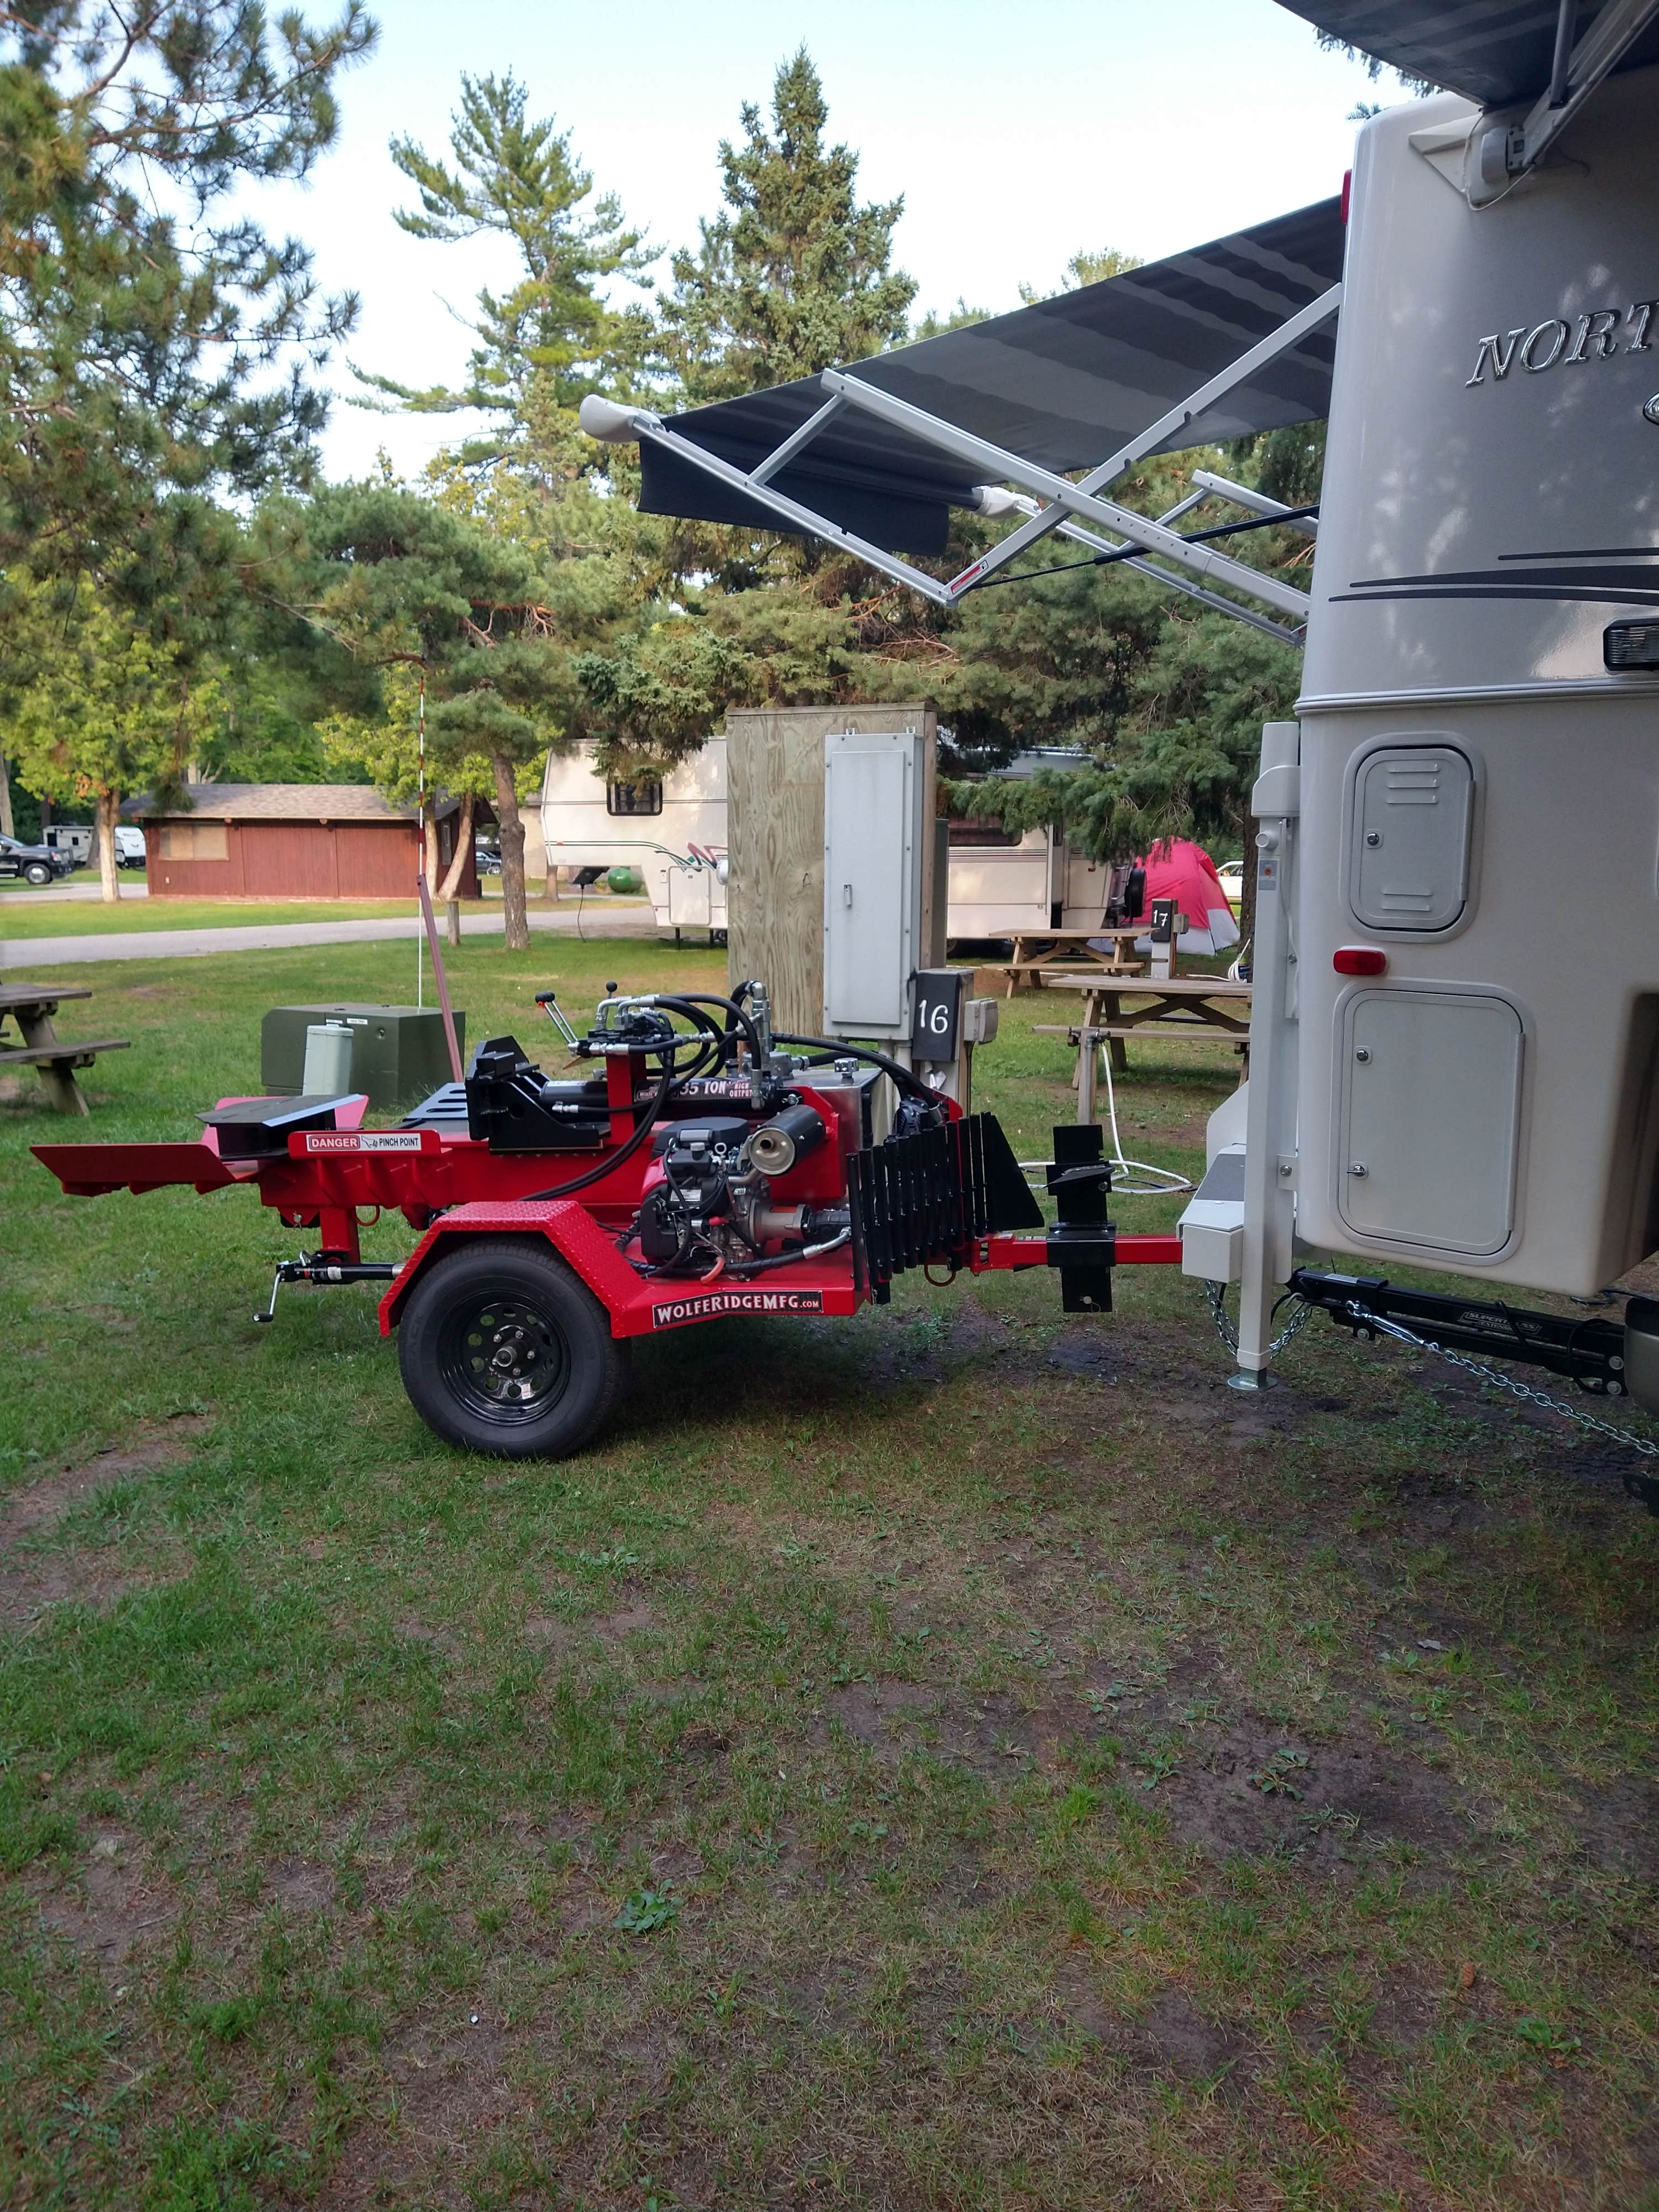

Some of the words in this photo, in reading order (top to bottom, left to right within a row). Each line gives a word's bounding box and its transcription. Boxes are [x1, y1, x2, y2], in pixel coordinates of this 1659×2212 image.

[1465, 300, 1659, 387] NORT
[1154, 910, 1168, 926] 17
[919, 999, 948, 1034] 16
[680, 1082, 699, 1095] 35
[704, 1081, 726, 1094] TON
[311, 1138, 358, 1147] DANGER
[379, 1138, 398, 1146] PINCH
[400, 1137, 419, 1146] POINT
[1468, 1313, 1535, 1329] SUPERTUSS
